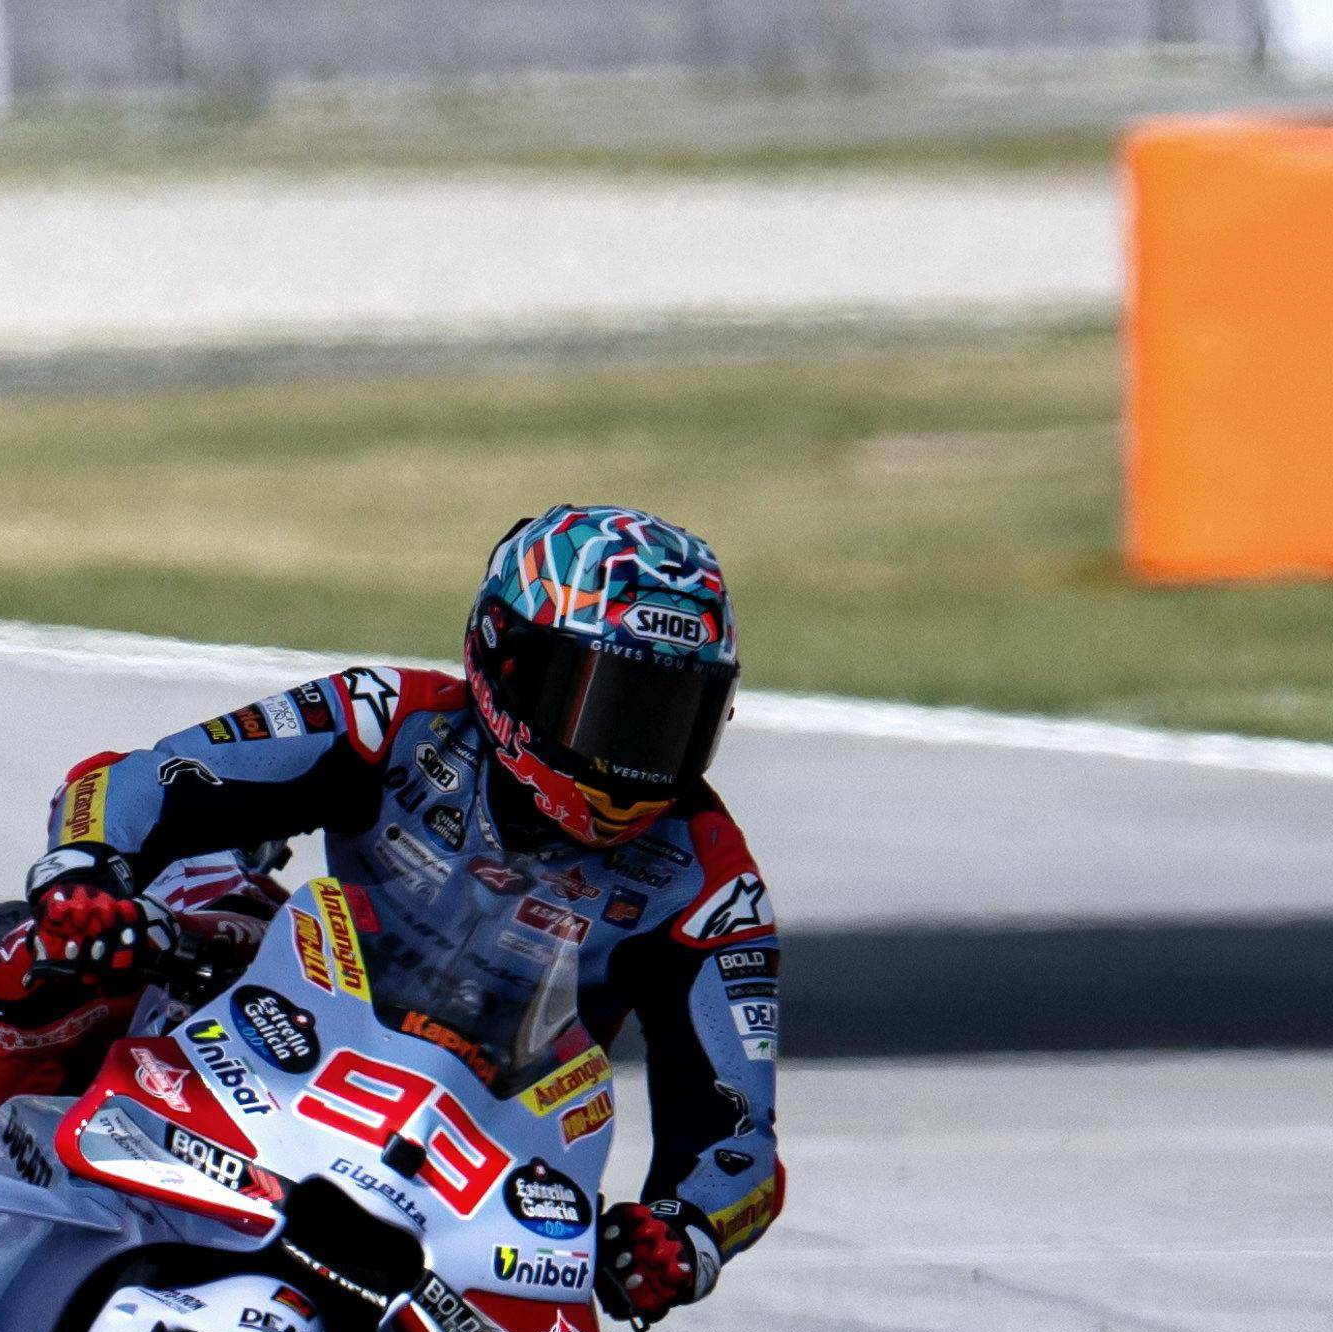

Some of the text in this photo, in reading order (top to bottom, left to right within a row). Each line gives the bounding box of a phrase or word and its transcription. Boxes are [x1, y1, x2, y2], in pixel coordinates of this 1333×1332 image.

[636, 609, 701, 641] SHOEI
[590, 639, 645, 662] GIVES
[652, 655, 685, 673] YOU
[611, 764, 674, 785] VERTICAL
[65, 772, 102, 840] Antangin
[318, 881, 365, 991] Antangin
[719, 951, 765, 969] BOLD
[244, 1002, 292, 1061] Galicia
[257, 996, 310, 1058] Estrella
[185, 1018, 273, 1116] Unibat
[534, 1053, 609, 1112] Antangin
[171, 1129, 244, 1181] BOLD
[292, 1047, 516, 1220] 93
[328, 1157, 428, 1229] Gigetta
[515, 1177, 576, 1203] Estrella
[520, 1198, 580, 1222] Galicia
[493, 1246, 590, 1290] Unibat
